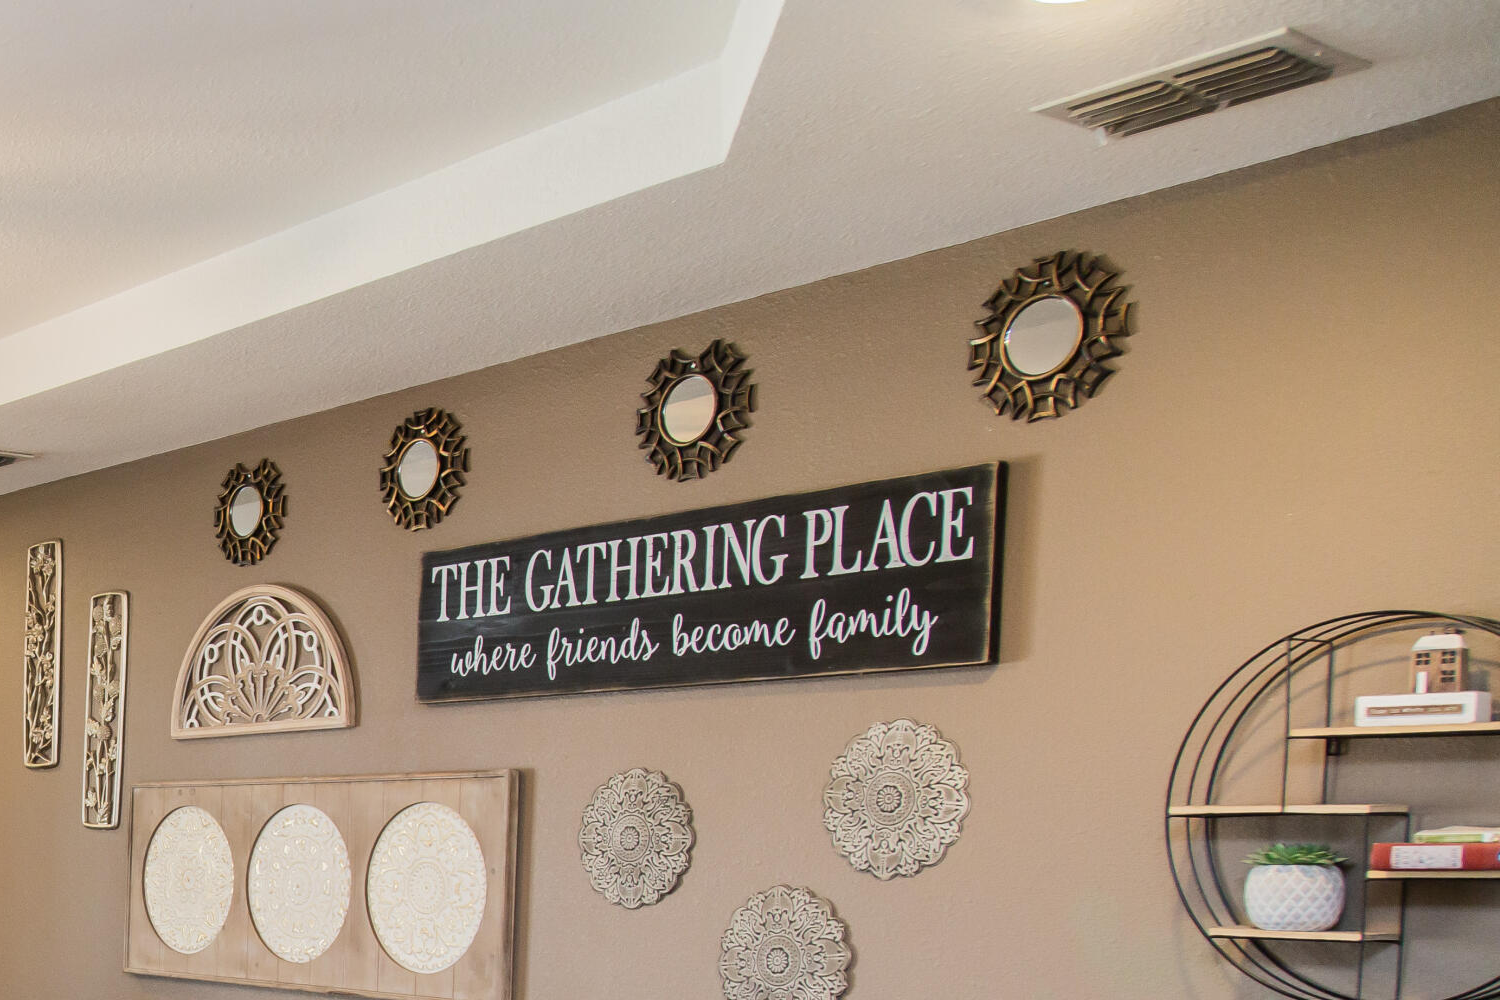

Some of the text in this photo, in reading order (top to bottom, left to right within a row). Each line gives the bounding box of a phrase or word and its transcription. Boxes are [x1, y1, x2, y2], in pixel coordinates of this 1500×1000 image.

[431, 486, 974, 622] THE GATHERING PLACE
[451, 587, 939, 680] where friends become family
